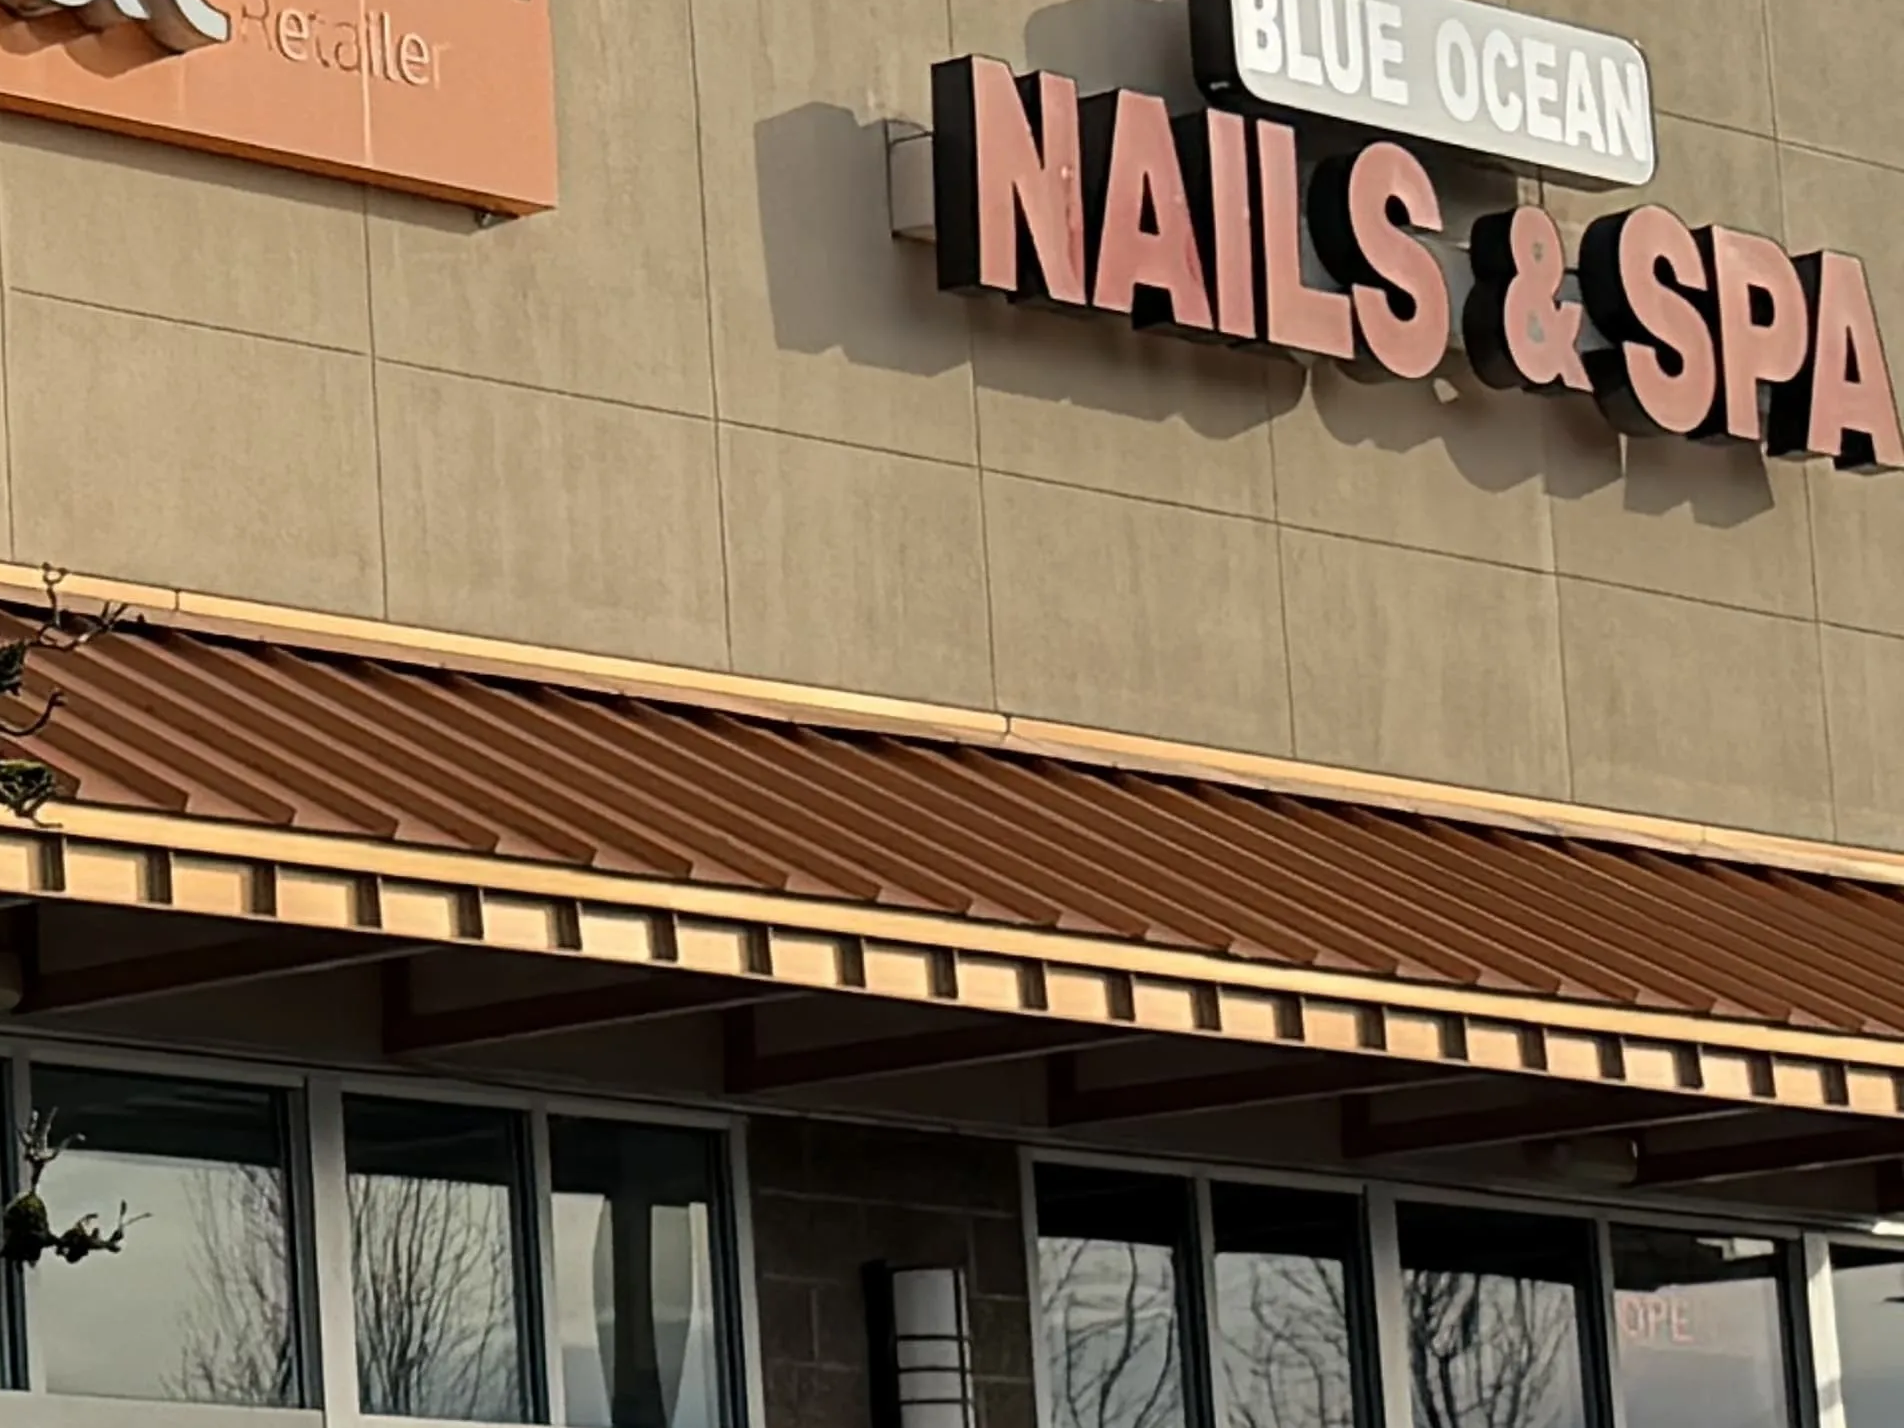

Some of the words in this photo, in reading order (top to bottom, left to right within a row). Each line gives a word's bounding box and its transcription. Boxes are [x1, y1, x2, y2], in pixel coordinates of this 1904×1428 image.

[1436, 18, 1648, 162] OCEAN
[971, 54, 1450, 379] NAILS
[1503, 204, 1591, 391] &
[1617, 202, 1904, 468] SPA
[1621, 1296, 1696, 1345] OPE
